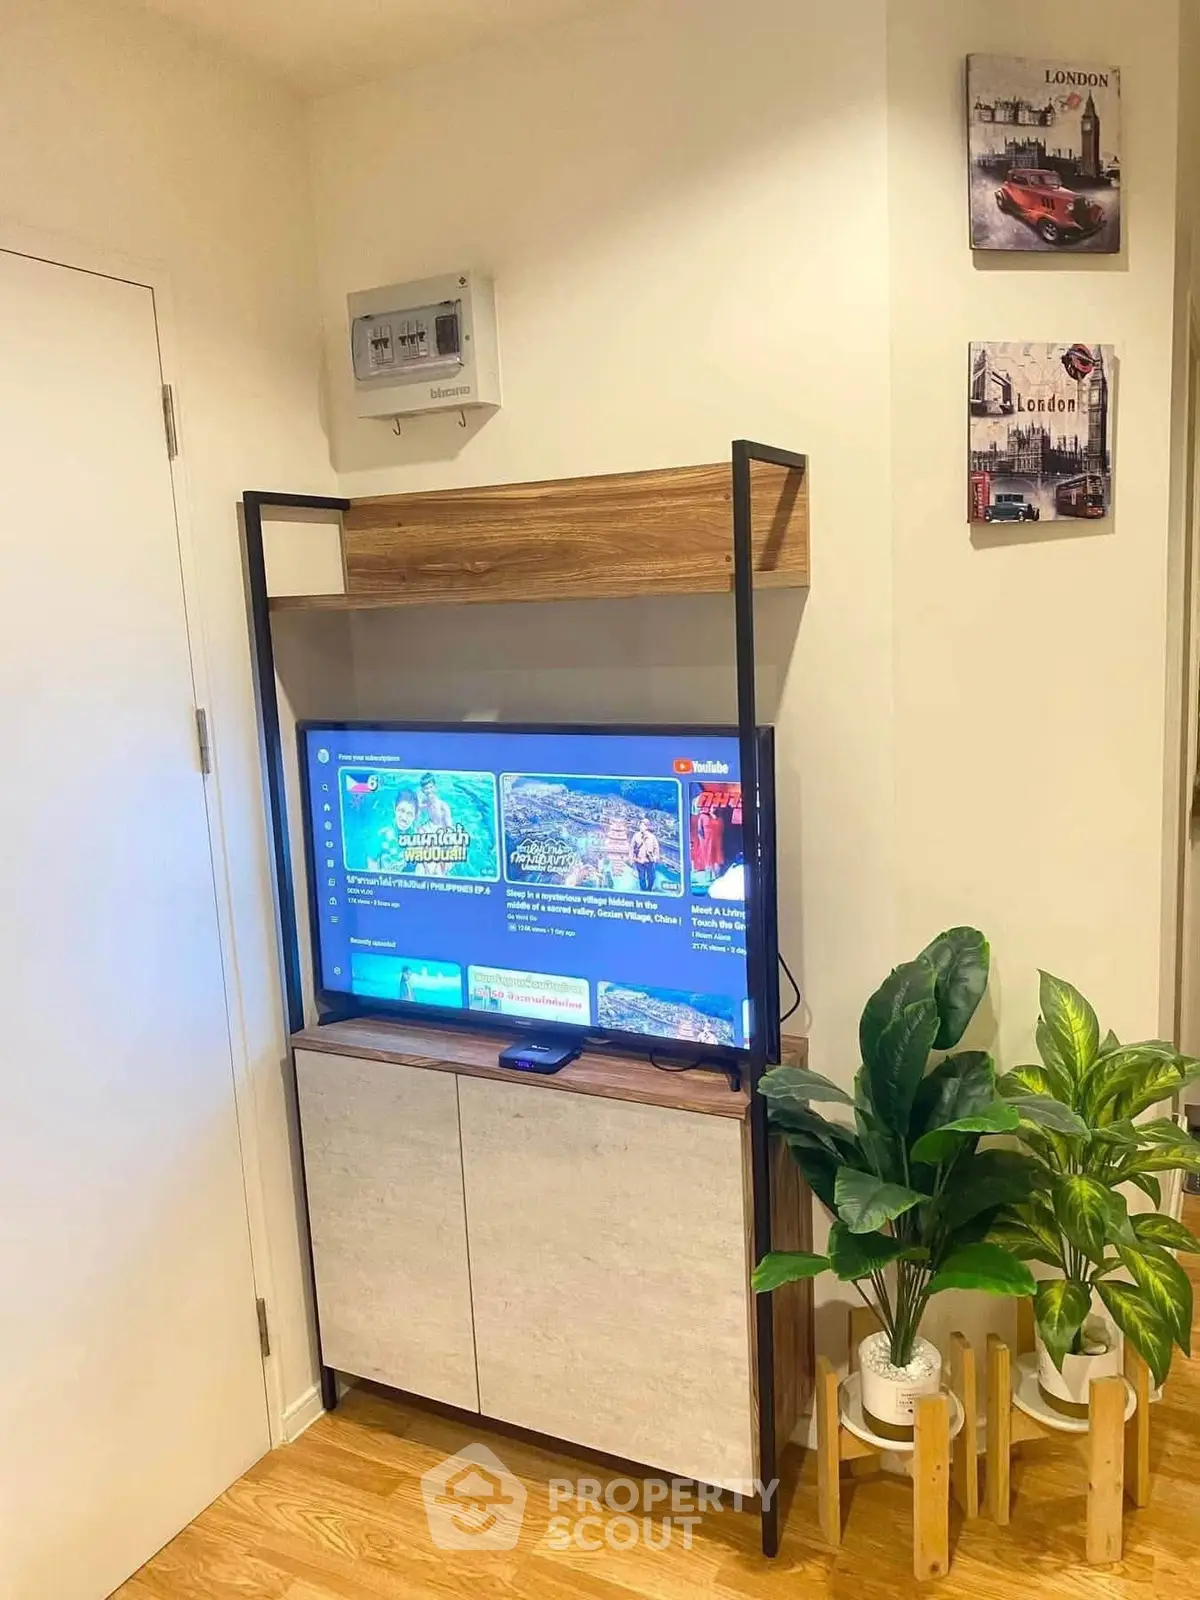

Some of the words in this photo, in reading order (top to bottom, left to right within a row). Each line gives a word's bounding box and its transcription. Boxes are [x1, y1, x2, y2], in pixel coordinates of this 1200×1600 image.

[1045, 69, 1109, 88] LONDON
[1017, 393, 1076, 413] London
[692, 760, 729, 774] YouTube
[506, 888, 526, 900] Sleep
[527, 890, 535, 899] in
[541, 892, 582, 903] mysterious
[583, 895, 607, 908] village
[608, 896, 635, 908] hidden
[636, 900, 643, 909] in
[645, 901, 658, 910] the
[506, 902, 531, 911] middle
[531, 903, 540, 911] of
[547, 905, 572, 914] sacred
[573, 906, 595, 919] valley,
[654, 914, 677, 925] China
[691, 904, 712, 915] Meet
[714, 907, 722, 916] A
[691, 917, 718, 929] Touch
[719, 919, 733, 930] the
[713, 933, 732, 942] Alone
[691, 943, 709, 951] 217K
[709, 943, 727, 953] views
